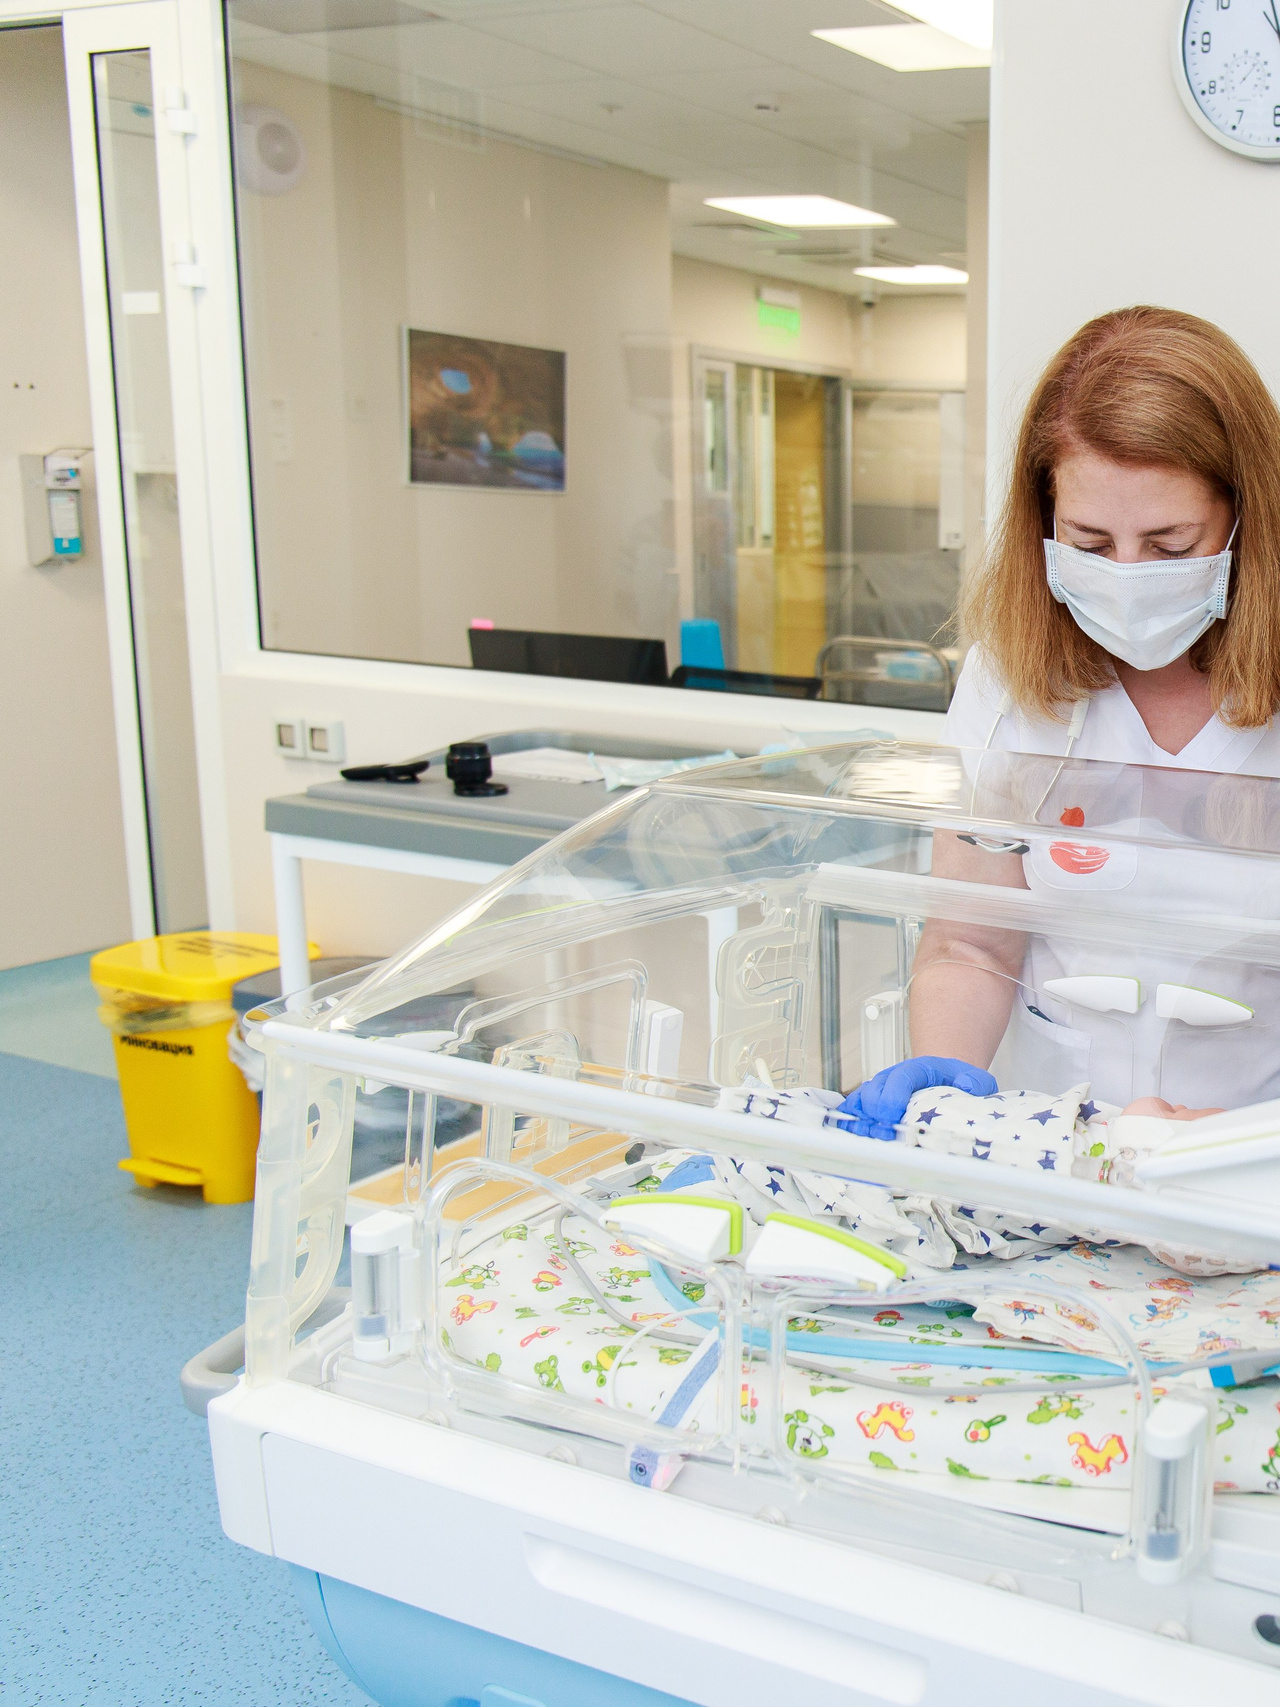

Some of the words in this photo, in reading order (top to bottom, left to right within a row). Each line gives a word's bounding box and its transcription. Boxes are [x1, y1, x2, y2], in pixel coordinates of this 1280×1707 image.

[1201, 31, 1212, 54] 9
[1208, 80, 1217, 95] 8
[1236, 109, 1244, 125] 7
